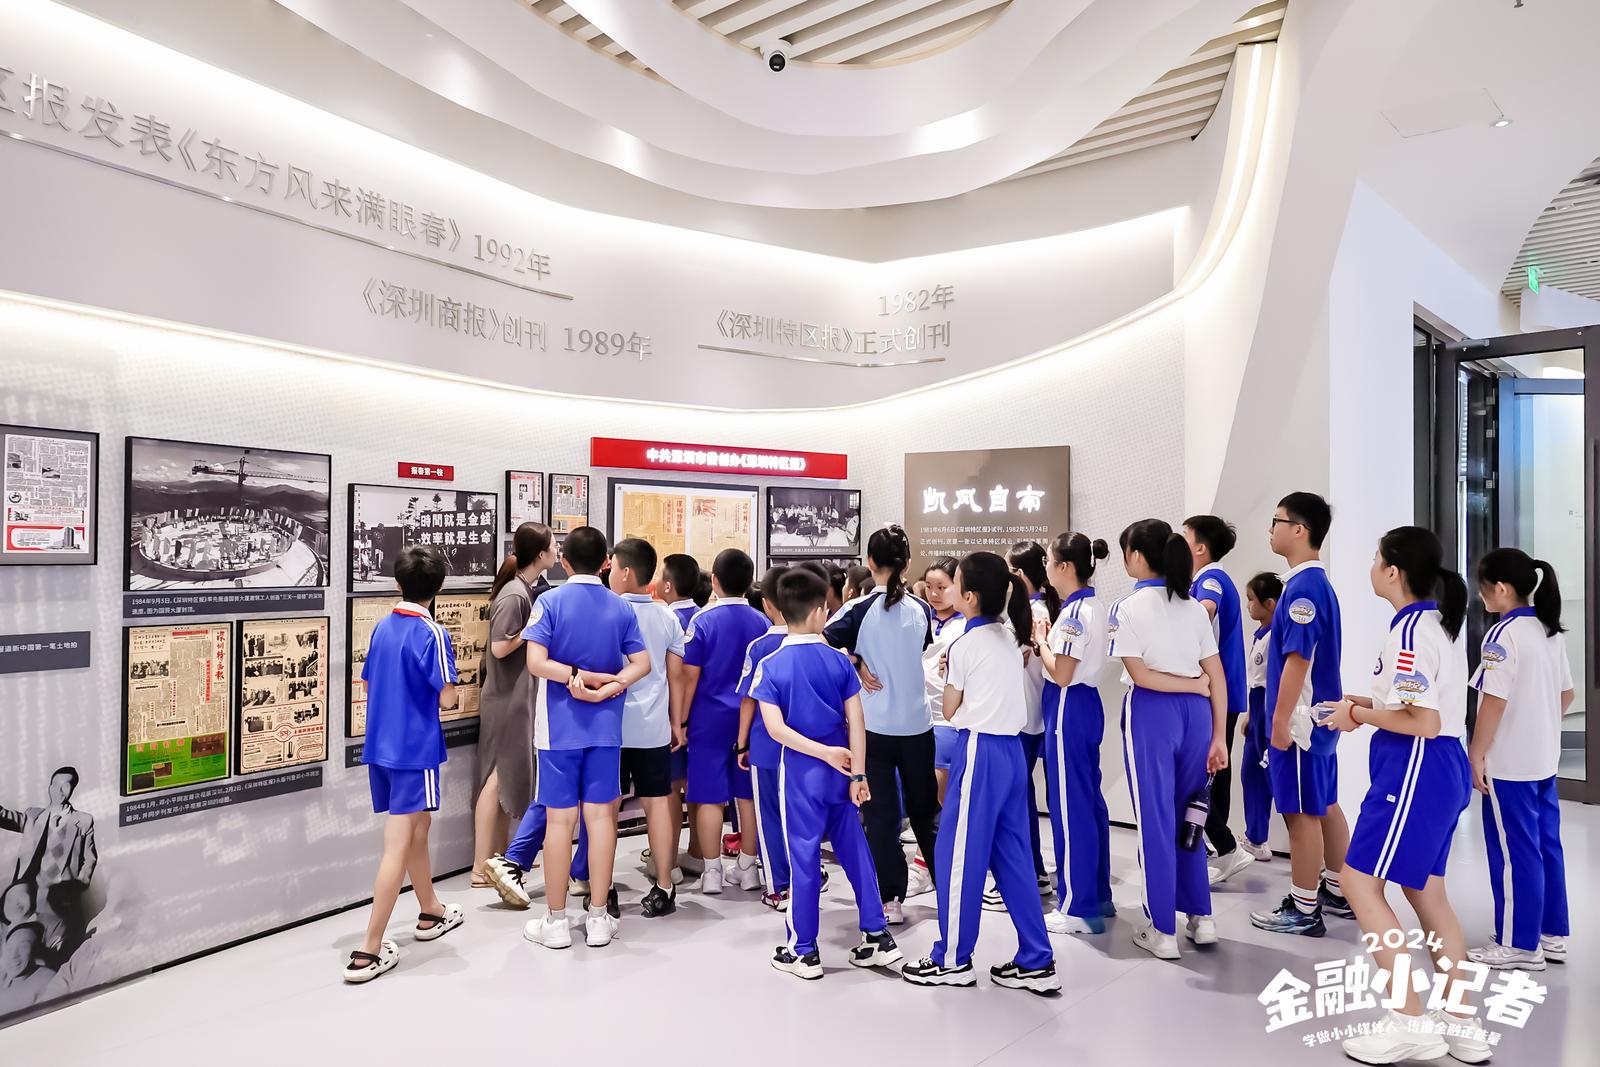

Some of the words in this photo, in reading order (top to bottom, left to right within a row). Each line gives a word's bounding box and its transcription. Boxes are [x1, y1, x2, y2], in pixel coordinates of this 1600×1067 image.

[473, 233, 551, 281] 1992年
[362, 277, 548, 353] 《深圳商报》创刊
[563, 326, 653, 361] 1989年
[878, 283, 955, 317] 1982年
[716, 308, 952, 355] 《深圳特区报》正式创刊
[420, 529, 492, 546] 效率就是生命
